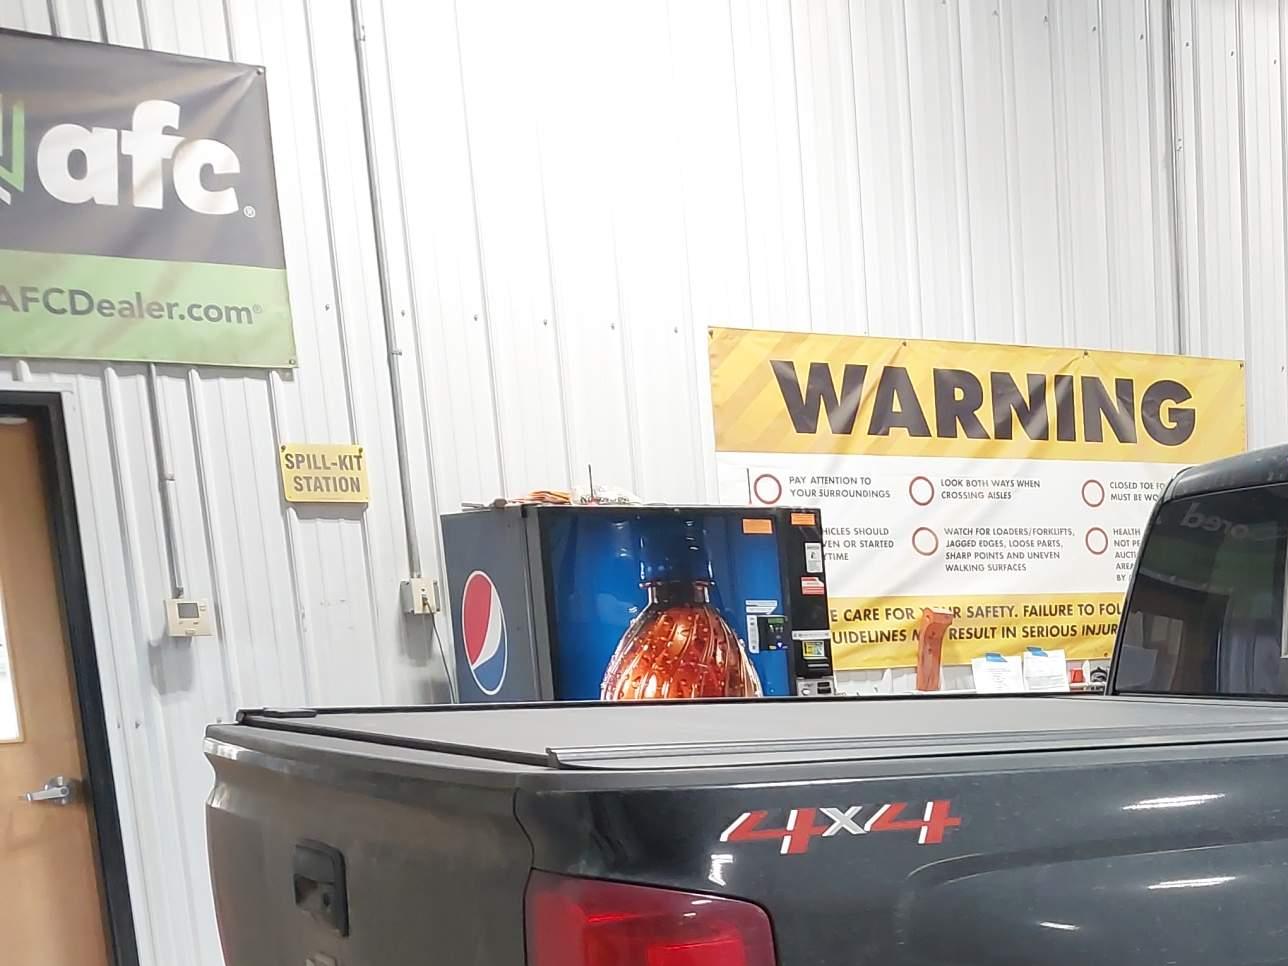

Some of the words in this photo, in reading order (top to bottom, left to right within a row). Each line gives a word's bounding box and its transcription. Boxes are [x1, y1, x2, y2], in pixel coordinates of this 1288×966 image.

[769, 360, 1196, 446] WARNING
[285, 453, 362, 471] SPILL-KIT
[293, 475, 361, 493] STATION
[789, 476, 806, 485] PAY
[810, 476, 859, 485] ATTENTION
[860, 477, 871, 485] TO
[941, 479, 963, 487] LOOK
[1017, 480, 1041, 488] WHEN
[791, 489, 818, 497] YOUR
[819, 489, 891, 498] SURROUNDINGS
[941, 491, 985, 499] CROSSING
[987, 491, 1012, 499] AISLES
[993, 528, 1075, 536] LOADERS/FORKLIFTS,
[843, 540, 857, 548] OR
[860, 540, 895, 548] STARTED
[946, 540, 976, 548] JAGGED
[978, 540, 1006, 548] EDGES,
[1037, 540, 1064, 548] PARTS,
[945, 564, 985, 572] WALKING
[844, 608, 880, 622] CARE
[885, 607, 915, 620] FOR
[967, 605, 1018, 618] SAFETY.
[1023, 604, 1073, 617] FAILURE
[1078, 603, 1095, 616] TO
[832, 630, 907, 644] UIDELINES
[949, 627, 997, 640] RESULT
[1002, 626, 1017, 639] IN
[1022, 625, 1078, 638] SERIOUS
[1082, 624, 1117, 636] INJUR
